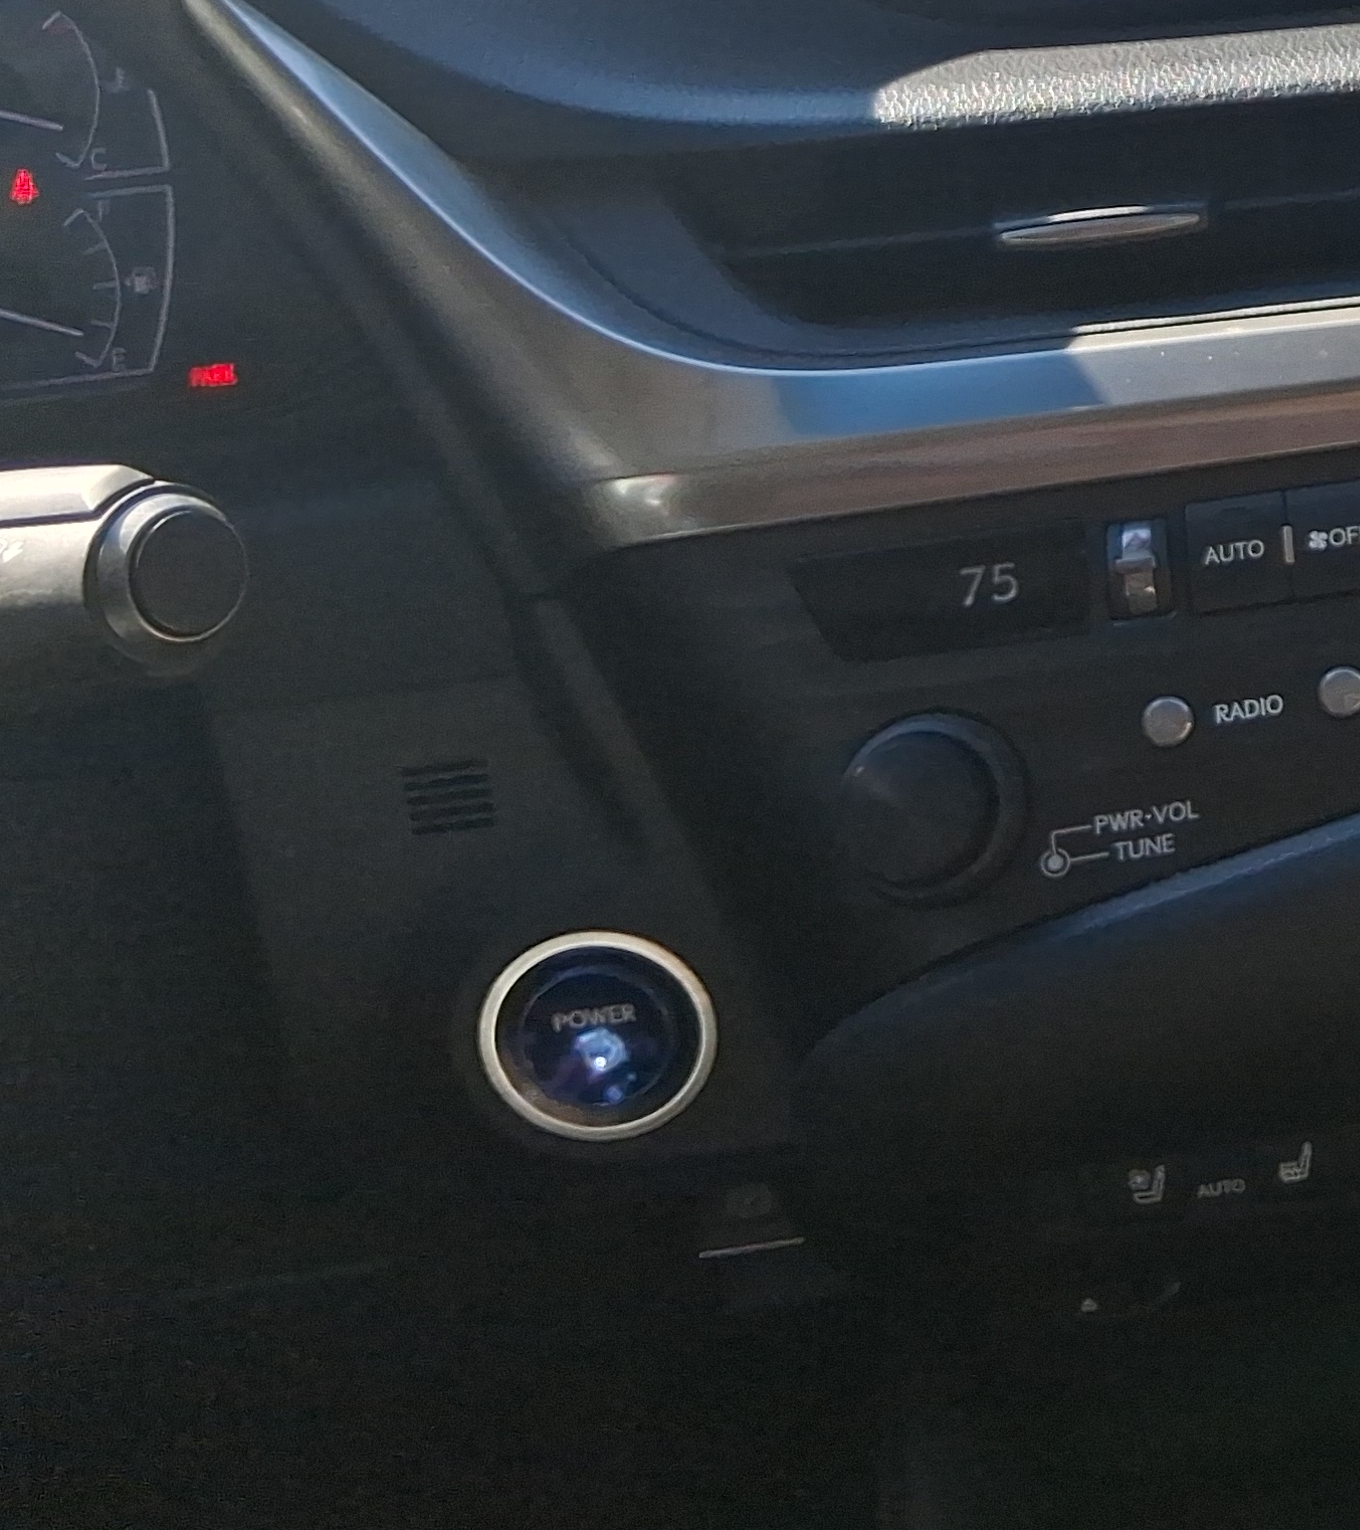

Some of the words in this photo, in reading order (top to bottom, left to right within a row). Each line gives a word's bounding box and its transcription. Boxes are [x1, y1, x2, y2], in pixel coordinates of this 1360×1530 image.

[1204, 540, 1265, 566] AUTO
[960, 562, 1018, 607] 75
[1214, 694, 1284, 724] RADIO
[1115, 834, 1176, 862] TUNE
[551, 1004, 637, 1032] POWER
[1197, 1178, 1246, 1199] AUTO
